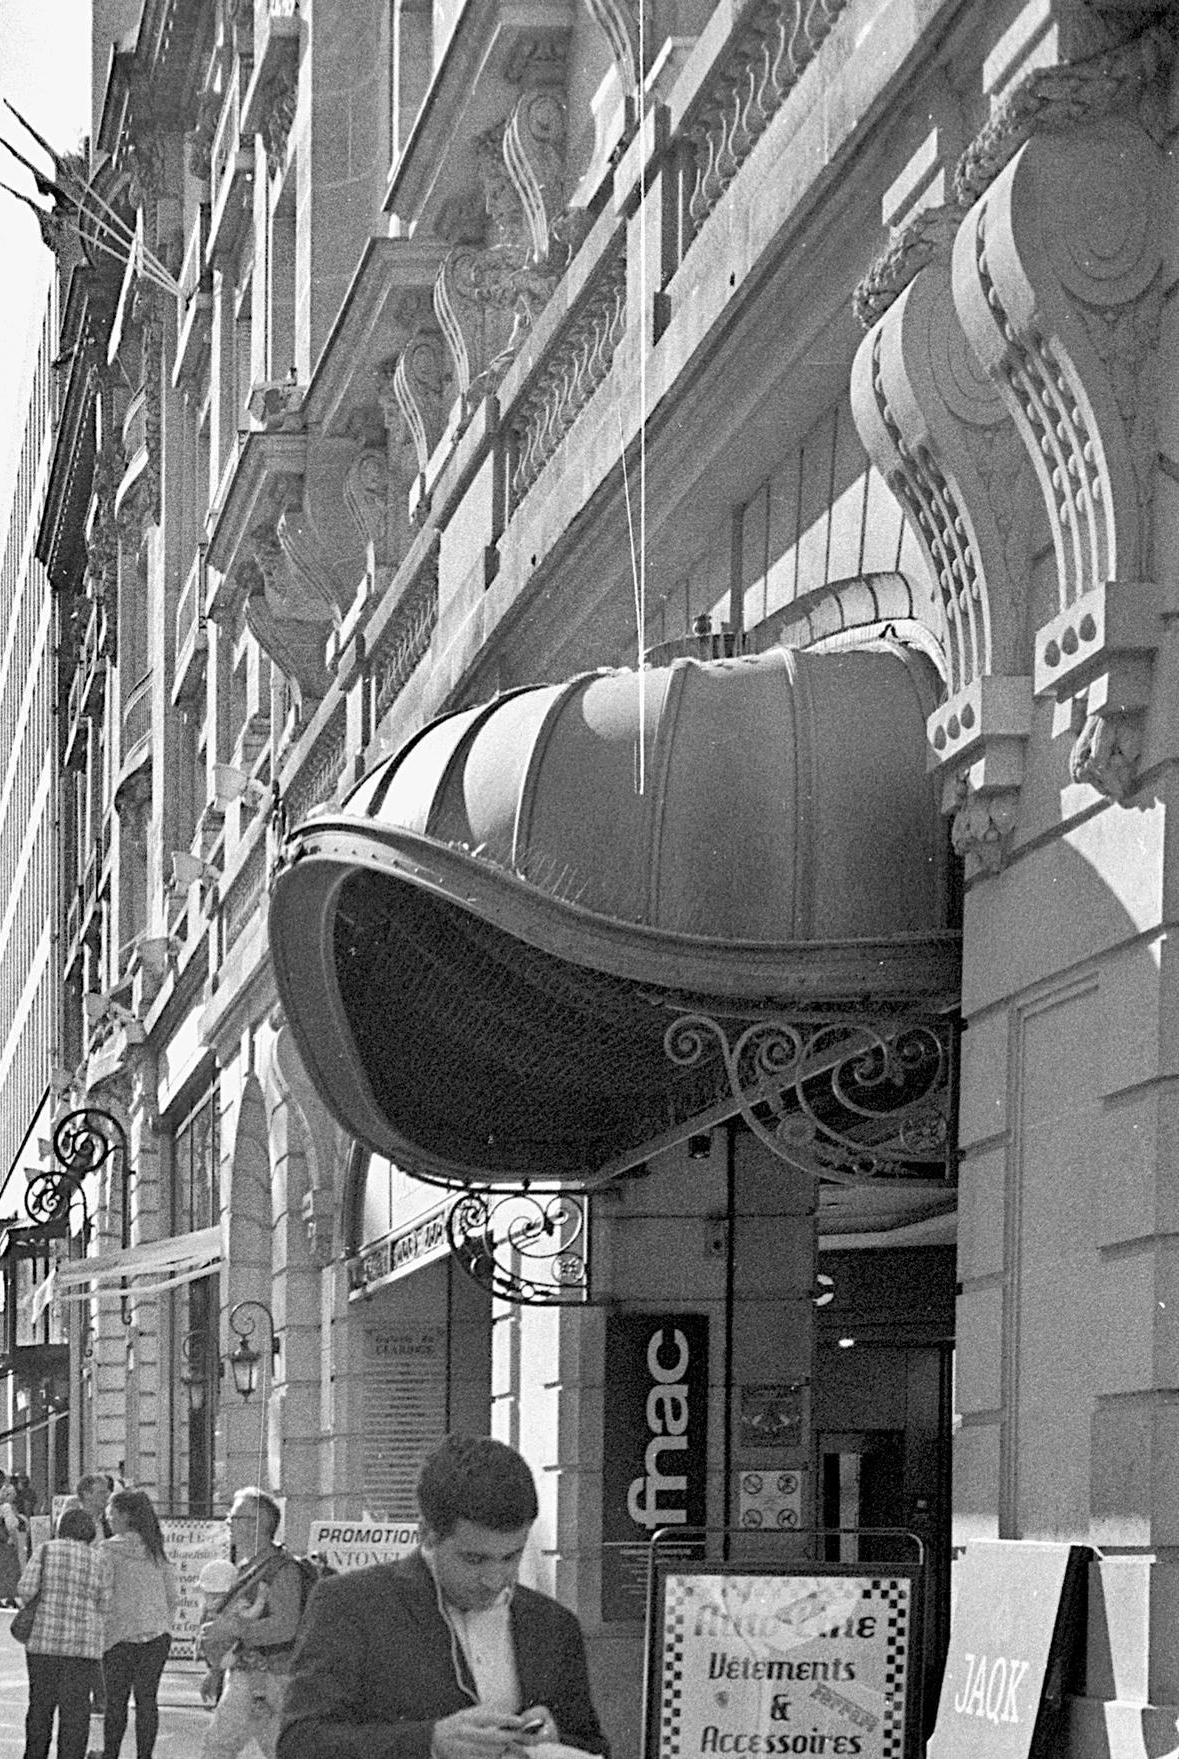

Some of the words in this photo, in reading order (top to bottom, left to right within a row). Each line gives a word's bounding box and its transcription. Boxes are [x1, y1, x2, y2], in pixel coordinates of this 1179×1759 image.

[627, 1328, 689, 1529] fnac
[770, 1694, 791, 1721] &
[954, 1653, 1030, 1724] JAQK
[700, 1725, 863, 1754] Accessoires
